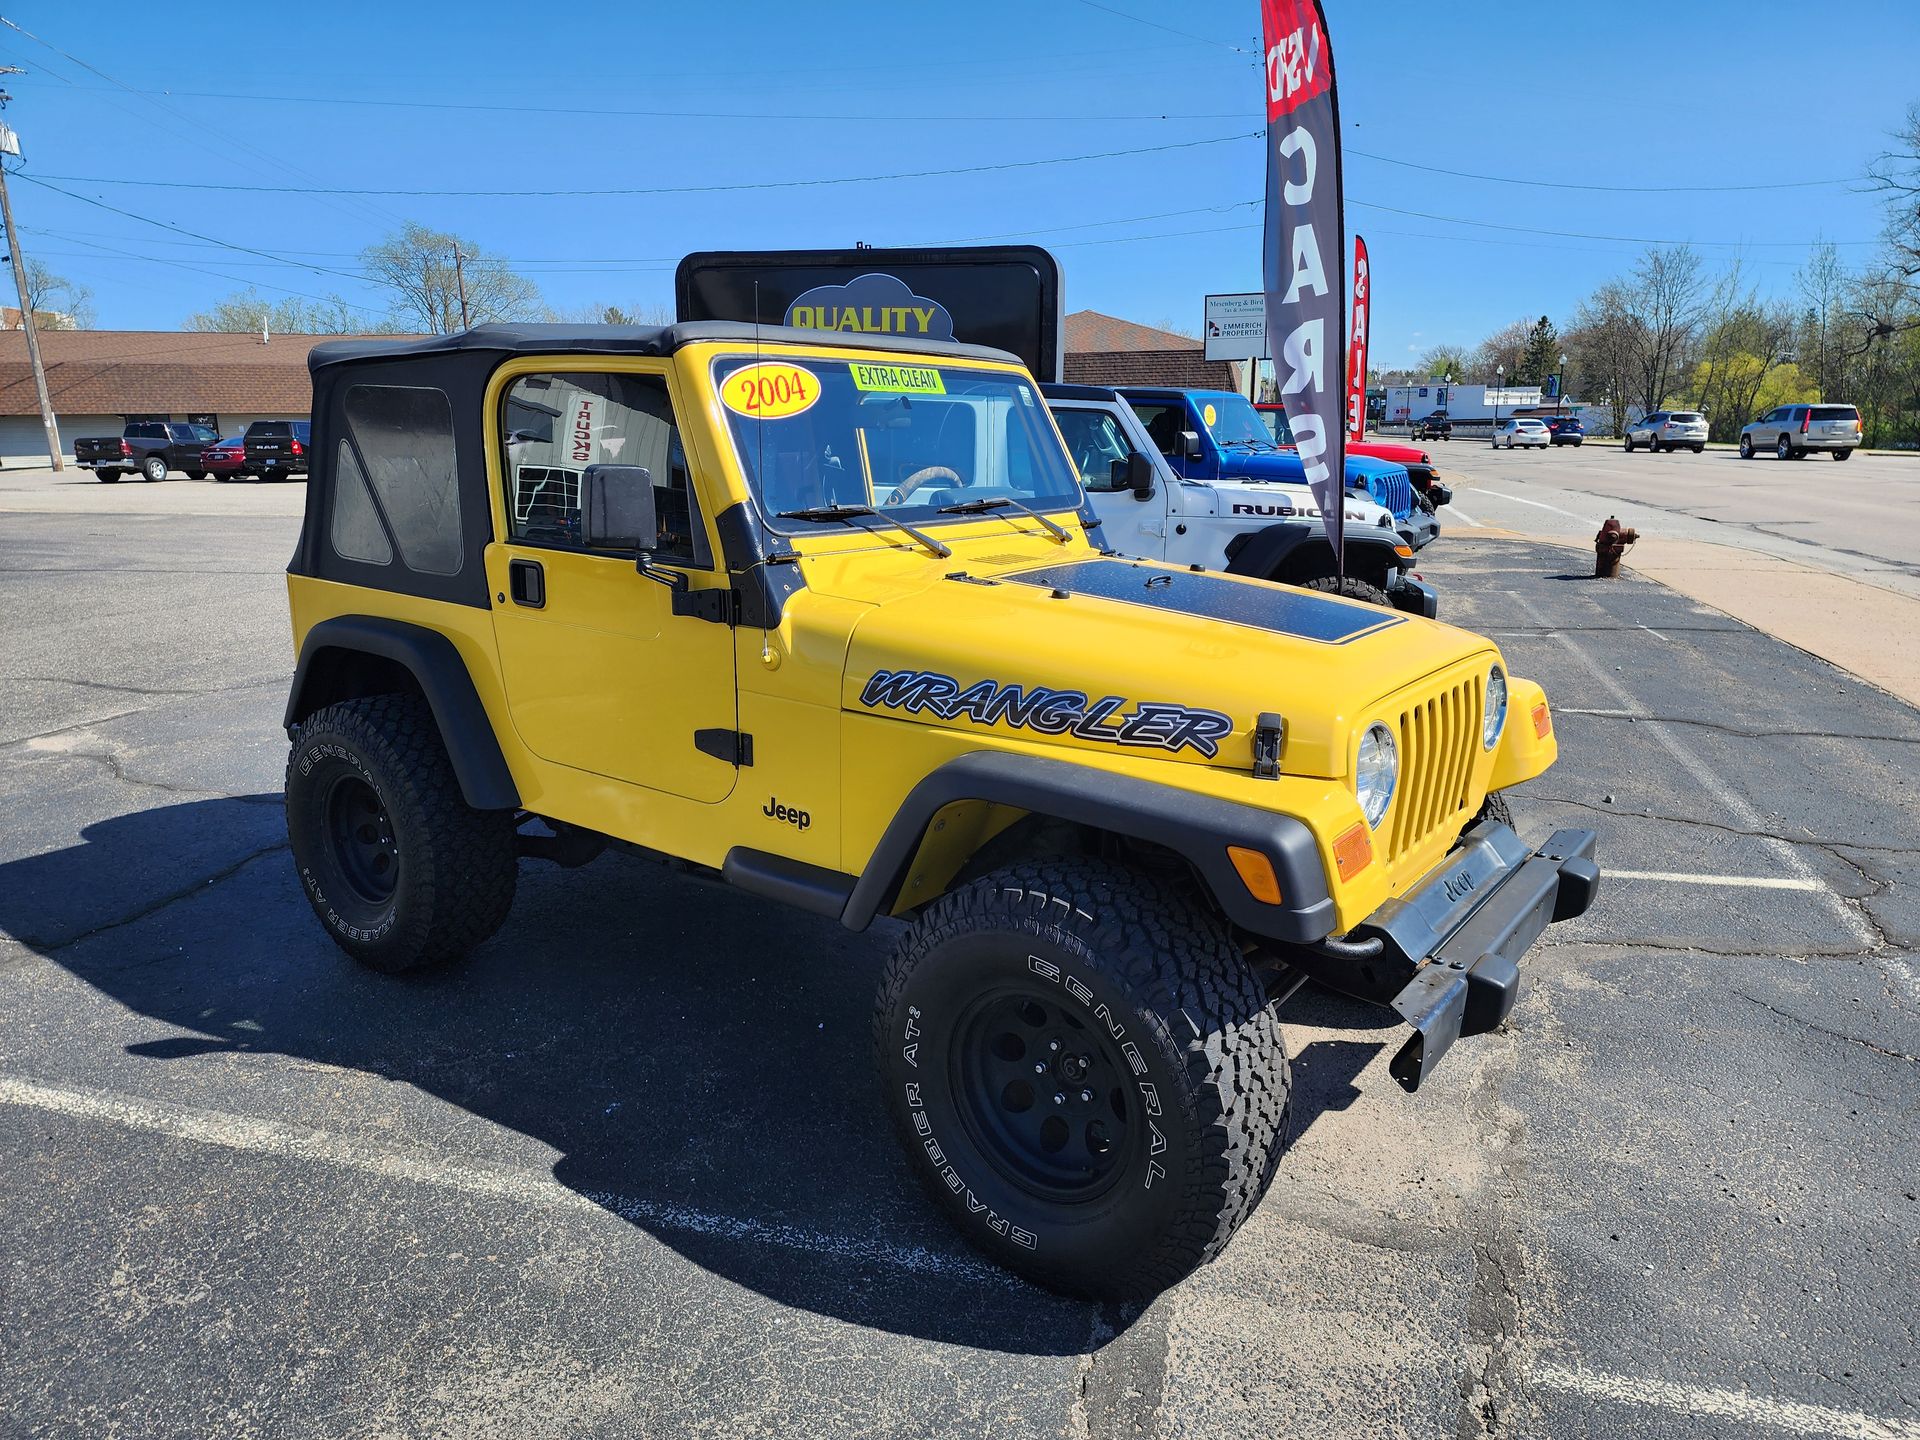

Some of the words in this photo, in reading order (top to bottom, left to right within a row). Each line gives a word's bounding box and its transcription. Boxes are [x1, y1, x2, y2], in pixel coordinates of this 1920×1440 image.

[792, 306, 936, 333] QUALITY
[741, 371, 807, 411] 2004
[857, 366, 900, 387] EXTRA
[899, 368, 937, 389] CLEAN
[1232, 504, 1366, 521] RUBICN
[859, 669, 1233, 760] WRANGLER
[763, 797, 811, 830] Jeep
[1443, 869, 1475, 903] Jeep
[1028, 954, 1167, 1190] GENERAL
[904, 1082, 1038, 1251] GRABBER
